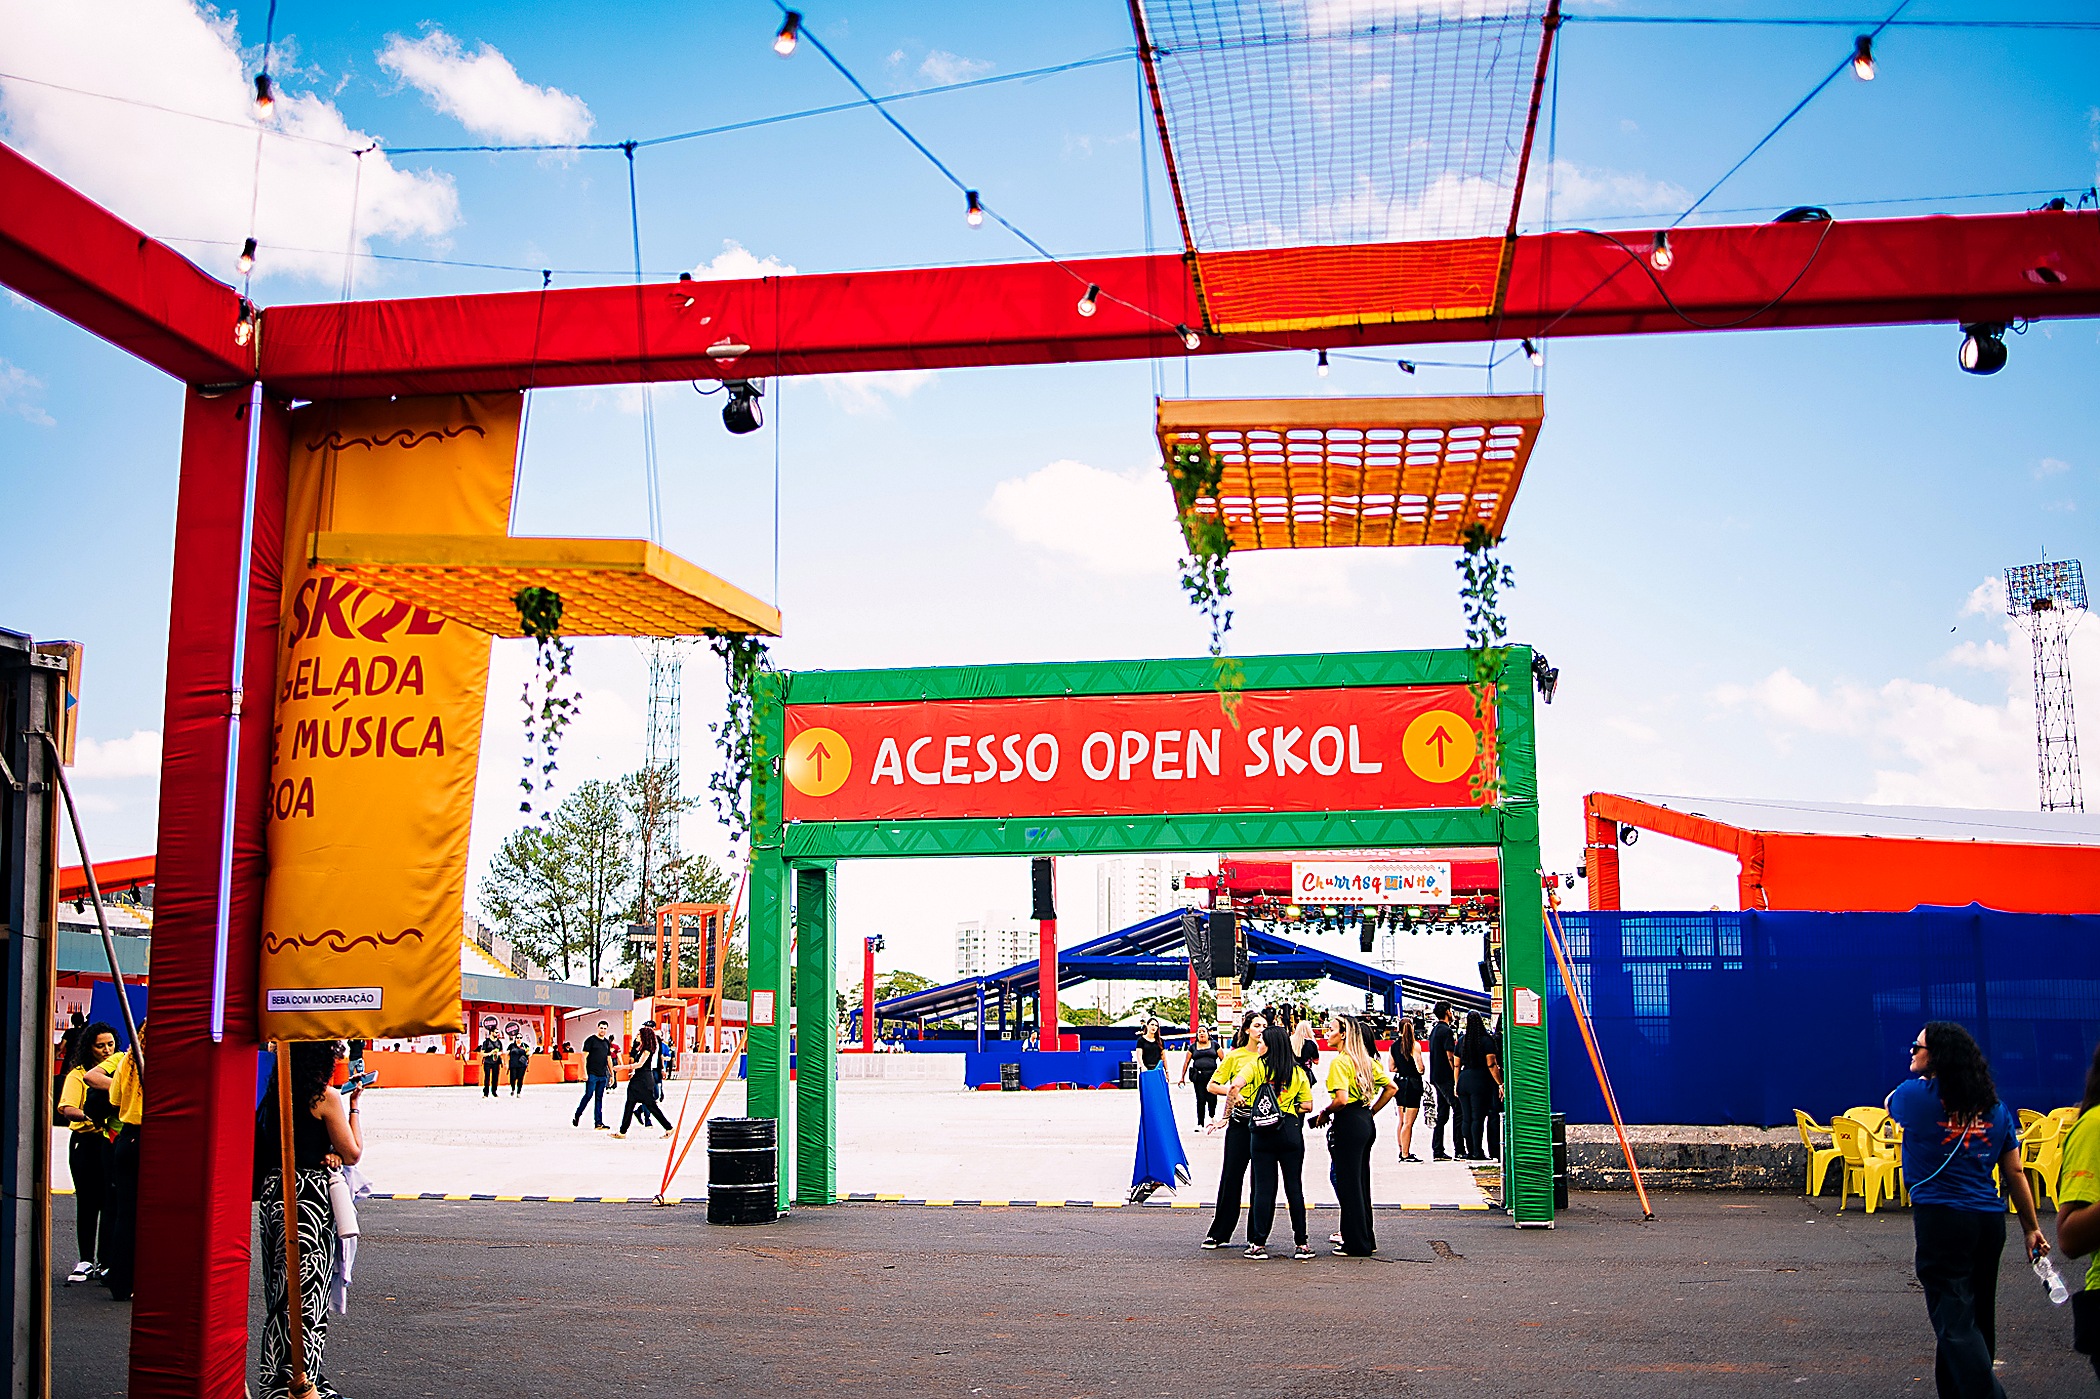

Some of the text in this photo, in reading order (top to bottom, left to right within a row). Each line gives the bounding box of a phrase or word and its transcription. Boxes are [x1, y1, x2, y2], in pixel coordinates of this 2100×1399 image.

[292, 698, 445, 760] MÚSICA
[870, 724, 1383, 785] ACESSO OPEN SKOL
[291, 996, 311, 1004] COM
[313, 993, 374, 1005] MODERAÇÃO
